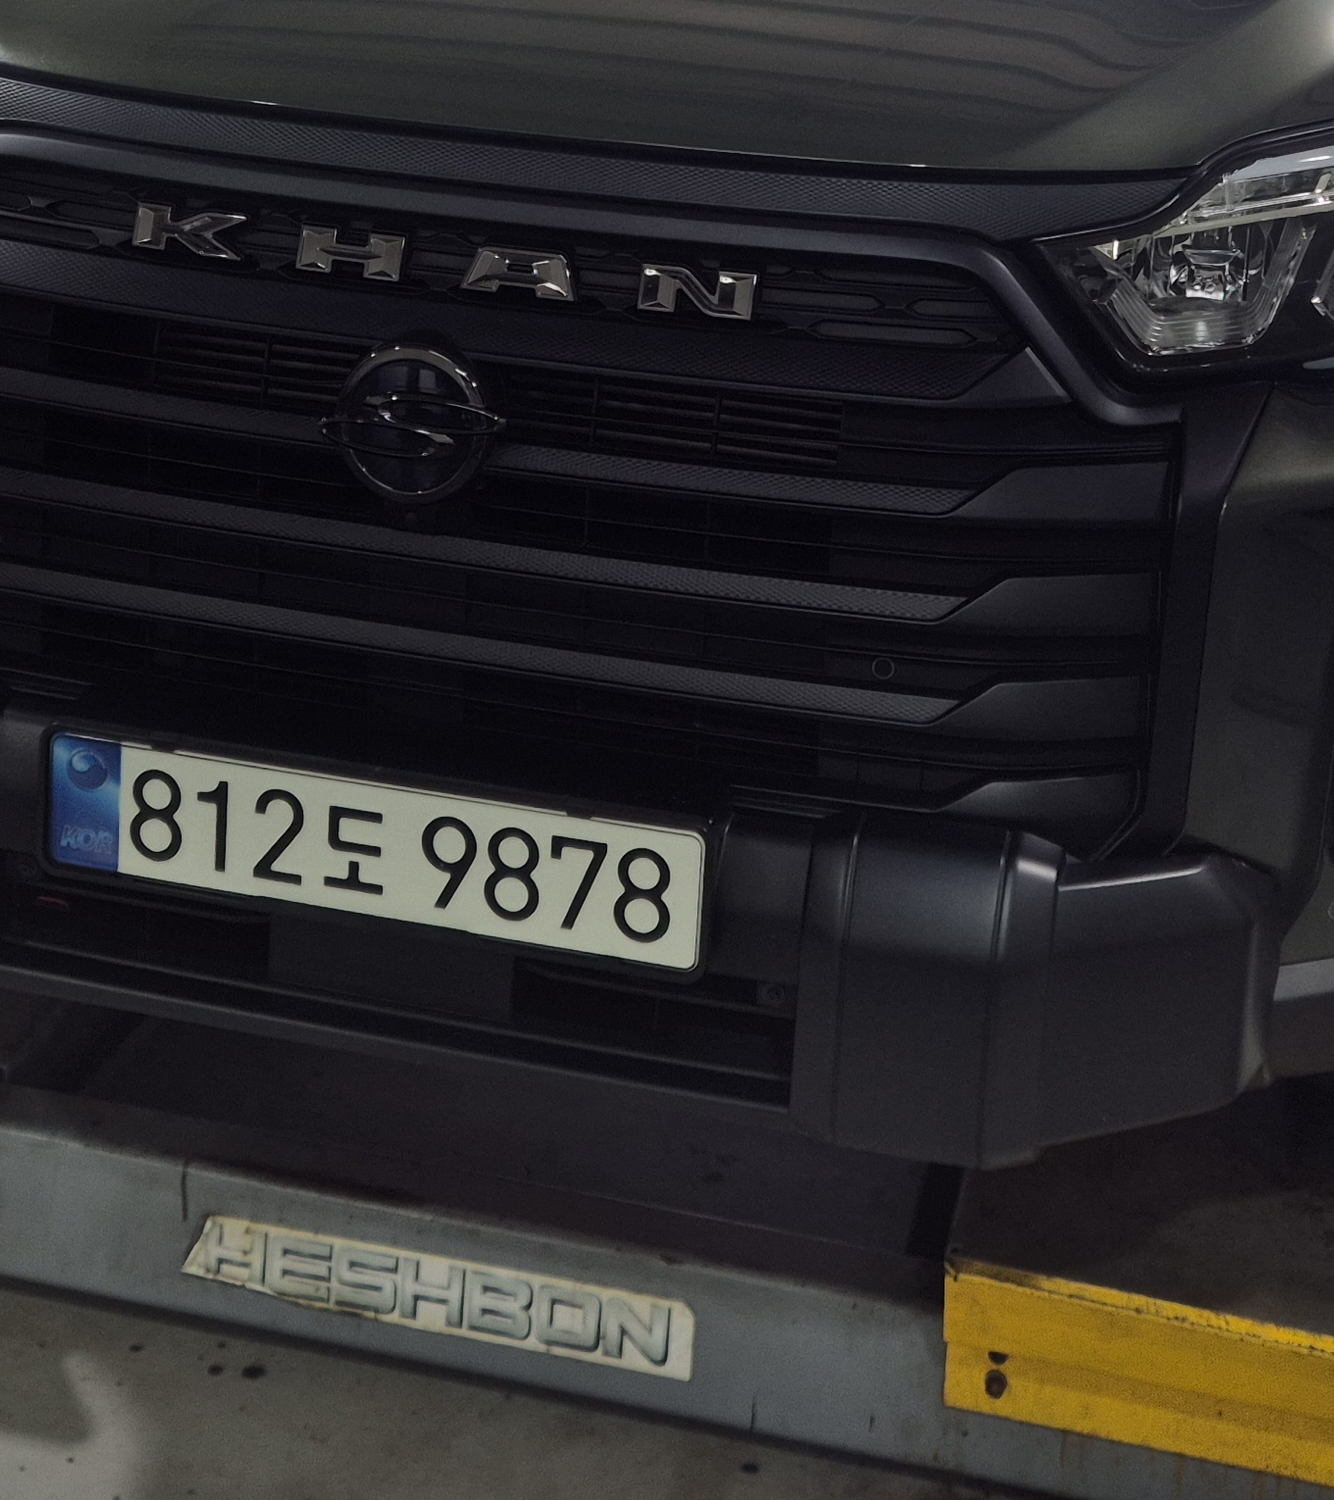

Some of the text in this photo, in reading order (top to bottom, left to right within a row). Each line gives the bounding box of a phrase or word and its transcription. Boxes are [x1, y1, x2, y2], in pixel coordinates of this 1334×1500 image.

[131, 202, 762, 321] KHAN
[60, 824, 113, 855] KOR
[204, 1220, 671, 1367] HESHBON
